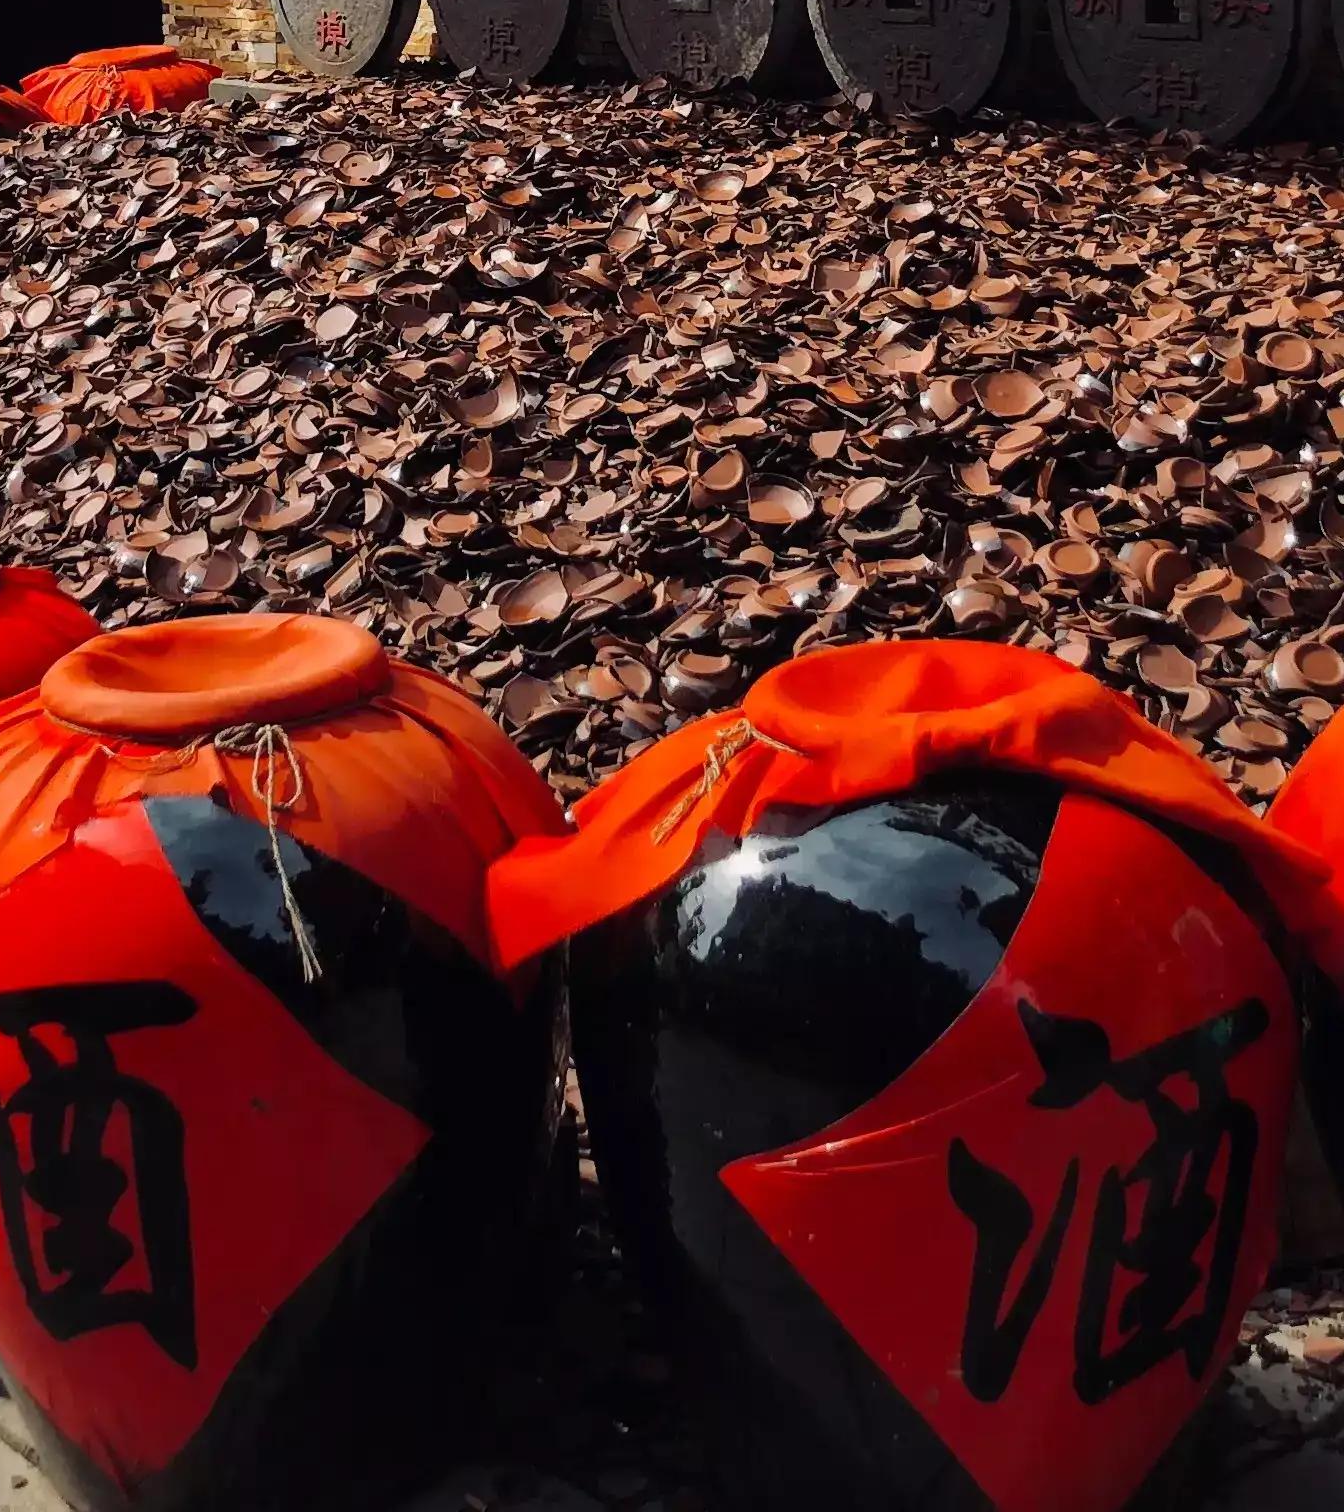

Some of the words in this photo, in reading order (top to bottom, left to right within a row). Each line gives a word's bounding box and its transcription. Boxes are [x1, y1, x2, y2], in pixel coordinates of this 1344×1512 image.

[317, 11, 351, 56] 掉
[482, 18, 520, 65] 掉
[883, 44, 941, 102] 掉
[1129, 62, 1207, 123] 掉
[945, 996, 1270, 1404] 酒
